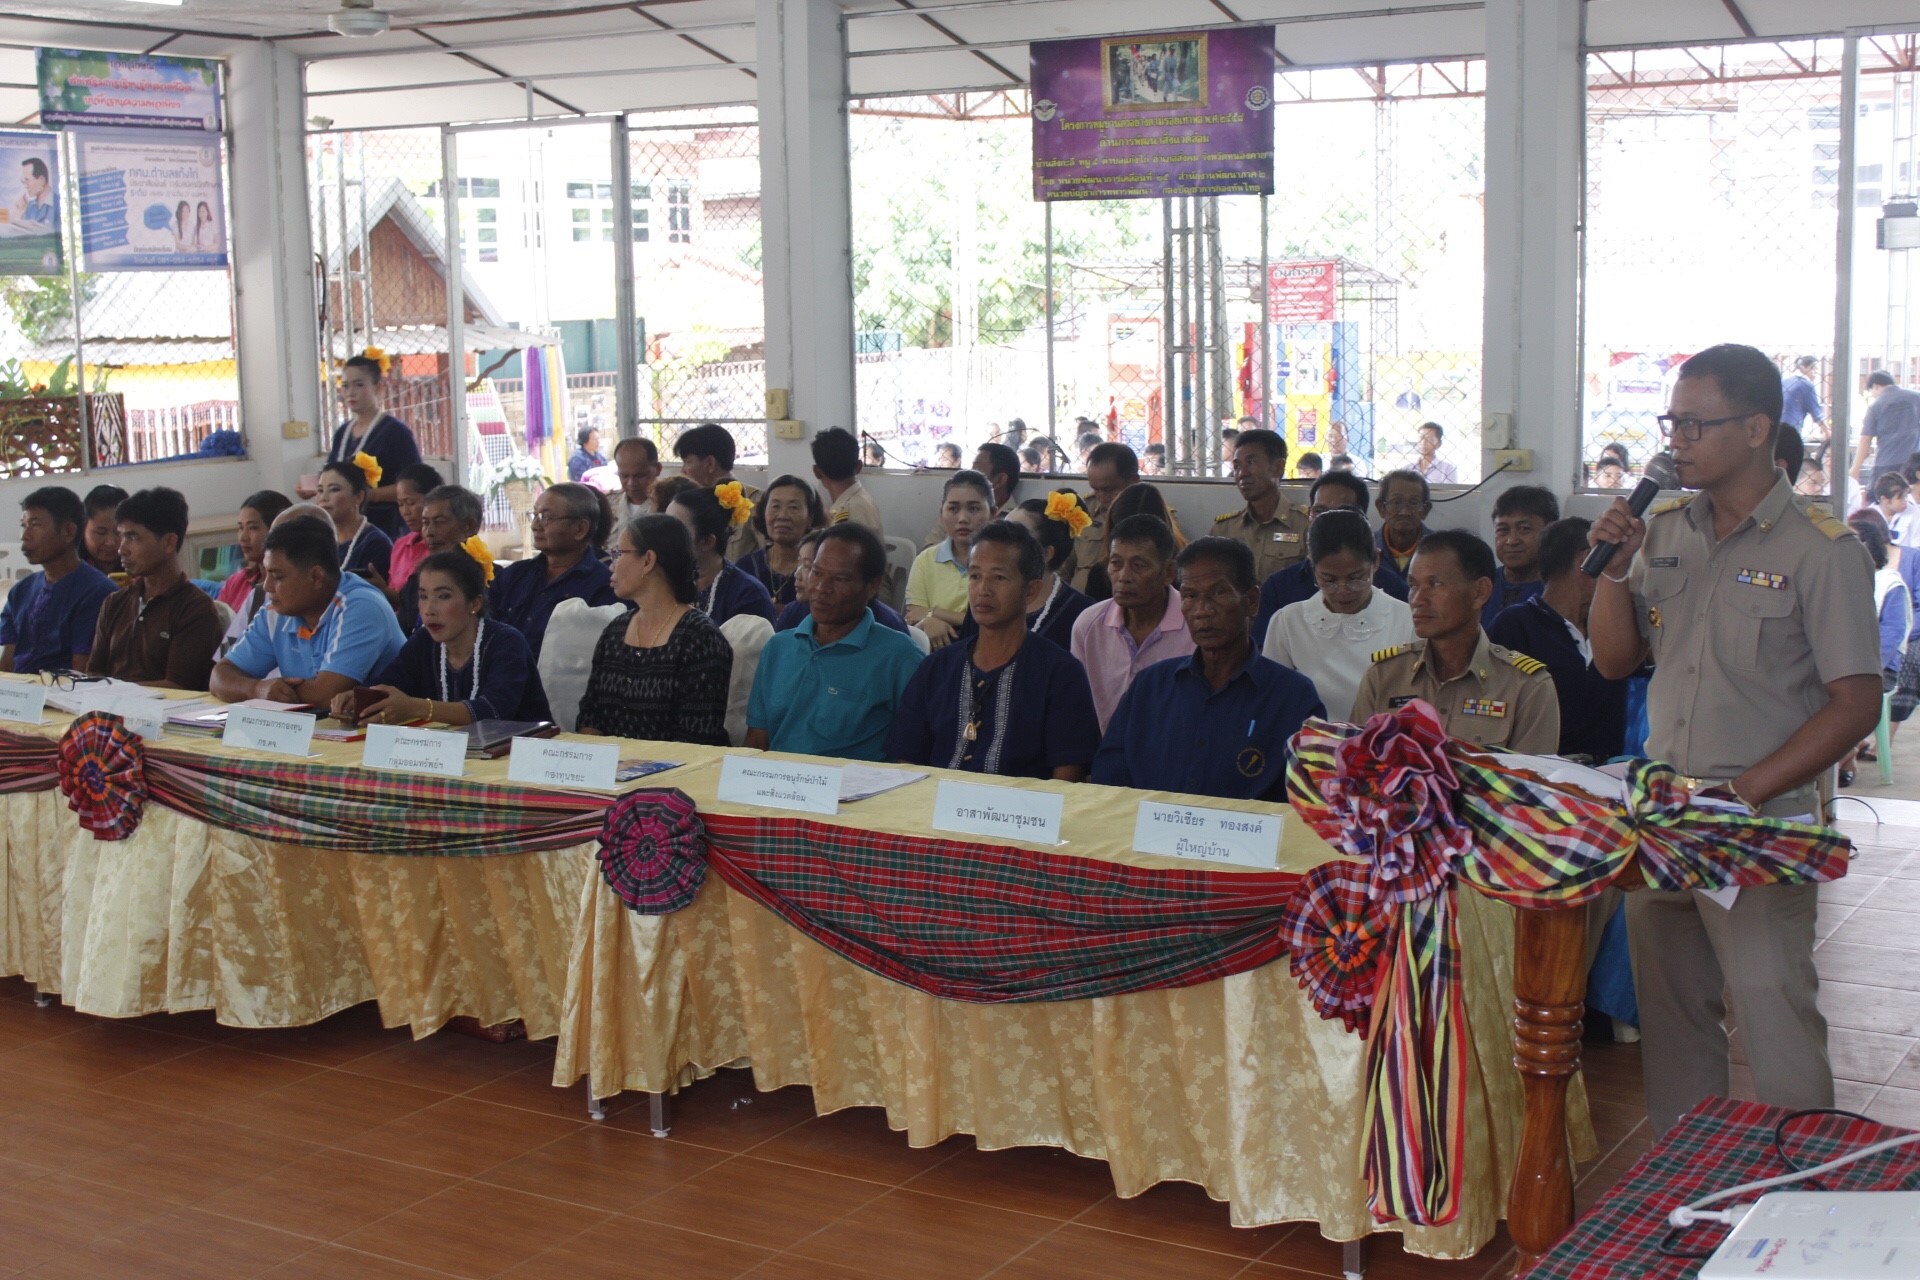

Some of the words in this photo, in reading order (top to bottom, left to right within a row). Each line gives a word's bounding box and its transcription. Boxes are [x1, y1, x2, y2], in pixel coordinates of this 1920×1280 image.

[242, 716, 303, 734] คณะกรรมการกองทุน
[395, 737, 442, 748] คณะกรรมการ
[542, 748, 594, 761] คณะกรรมการ
[545, 769, 586, 783] กองทุนขยะ
[742, 768, 828, 787] คณะกรรมการอนุรักษ์ป่าไม้
[756, 788, 806, 802] และสิ่งแวดล้อม
[956, 806, 1046, 829] อาสาพัฒนาชุมชน
[1153, 810, 1205, 827] นายวิเชียร
[1220, 819, 1263, 834] ทองสงค์
[1176, 837, 1230, 858] ผู้ใหญ่บ้าน
